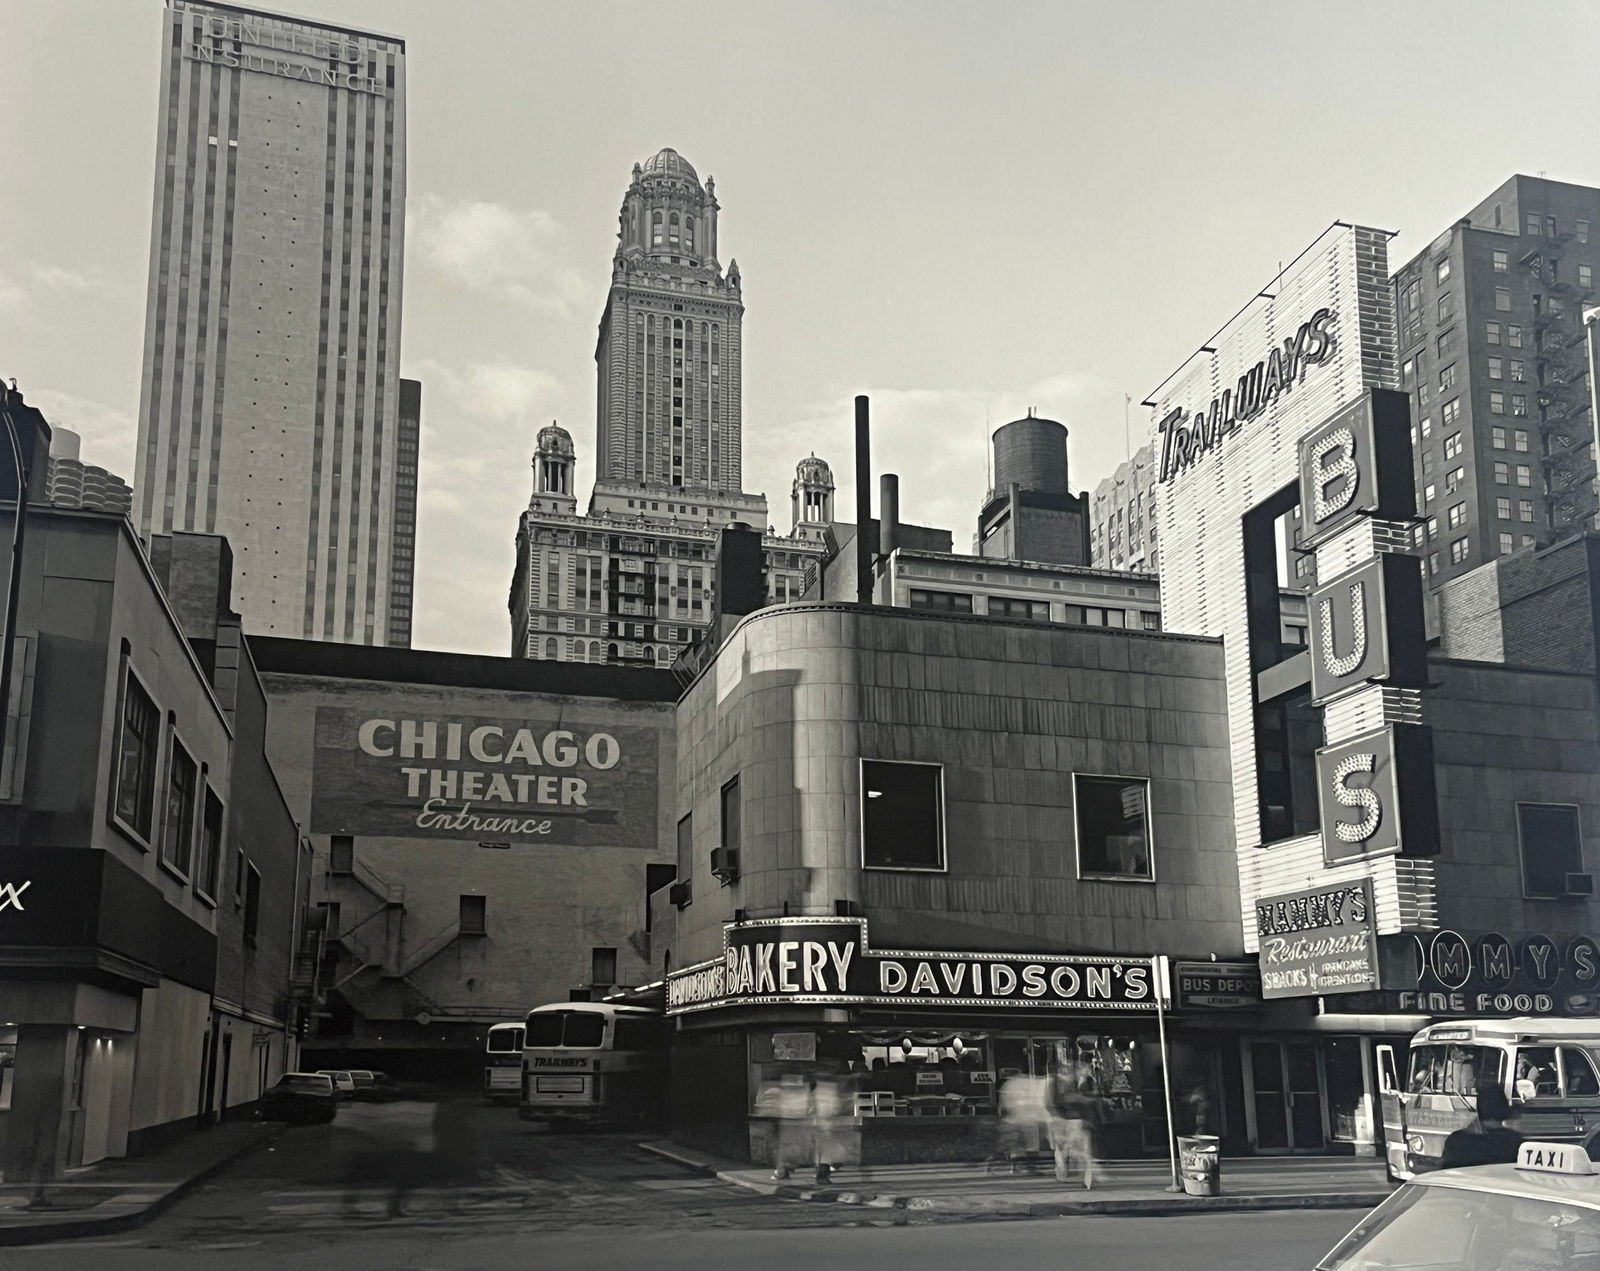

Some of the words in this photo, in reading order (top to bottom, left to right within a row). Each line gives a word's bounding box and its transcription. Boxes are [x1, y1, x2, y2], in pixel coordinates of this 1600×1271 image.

[204, 14, 363, 64] UNITED
[188, 43, 384, 95] NSURANCE
[1158, 307, 1337, 483] TRAILWAYS
[1310, 427, 1383, 844] BUS
[358, 719, 620, 770] CHICAGO
[401, 767, 588, 806] THEATER
[416, 798, 552, 834] Entrance
[1264, 927, 1371, 966] Restaurant
[1436, 941, 1596, 980] MMYS
[726, 941, 855, 995] BAKERY
[880, 961, 1149, 999] DAVIDSON'S
[1183, 978, 1211, 992] BUS
[1399, 993, 1466, 1011] FINE
[1476, 993, 1553, 1012] FOOD
[1525, 1149, 1564, 1169] TAXI
